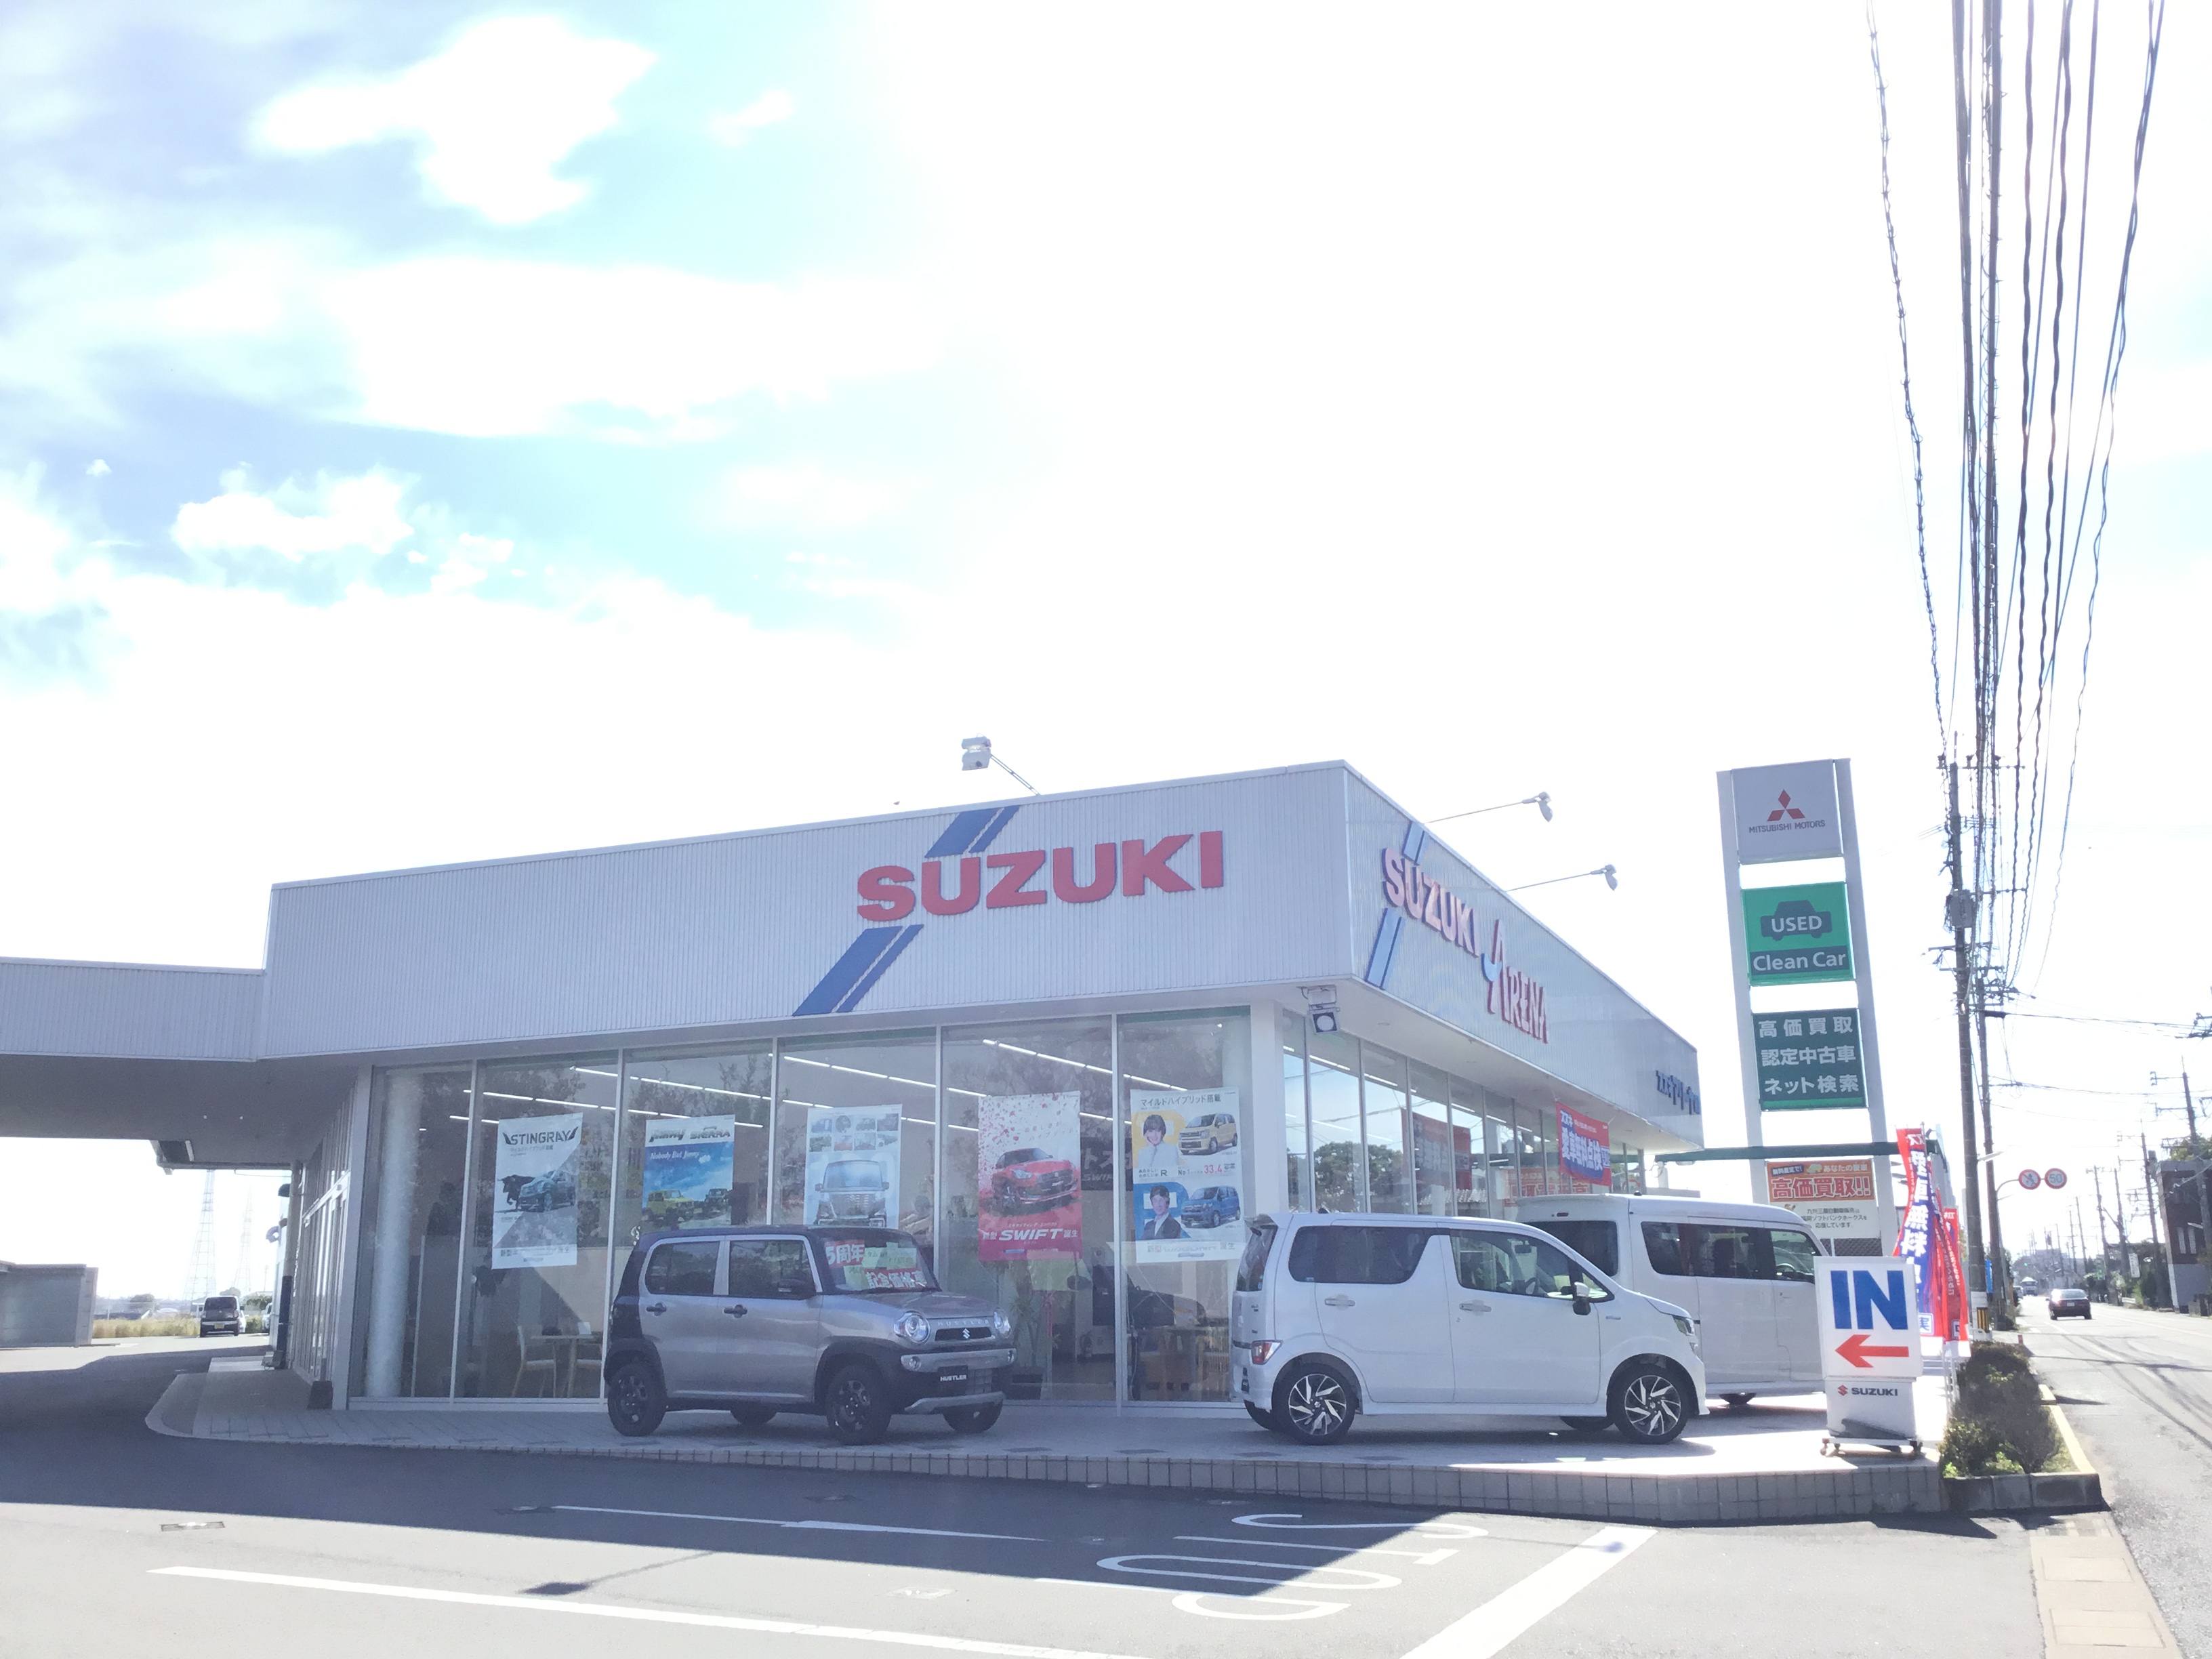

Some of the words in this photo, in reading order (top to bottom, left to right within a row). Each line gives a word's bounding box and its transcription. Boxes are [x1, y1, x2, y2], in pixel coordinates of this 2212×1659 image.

[1748, 823, 1793, 834] MITSUBISHI
[1795, 819, 1826, 830] MOTORS
[857, 830, 1223, 922] SUZUKI
[1771, 915, 1822, 933] USED
[1381, 847, 1480, 958] SUZUKI
[1481, 919, 1549, 1044] ARENA
[1753, 955, 1809, 971] Clean
[1812, 951, 1846, 967] Car
[1758, 1016, 1853, 1038] 高価買取
[1761, 1045, 1856, 1067] 認定中古車
[1764, 1074, 1859, 1095] ネット検索
[1141, 1093, 1222, 1107] マイルドハイブリッド搭載
[510, 1130, 571, 1145] STINGRAY
[2049, 1173, 2063, 1184] 50
[999, 1227, 1063, 1241] SWIFT
[825, 1244, 865, 1265] 5周年
[1830, 1270, 1909, 1330] IN
[1851, 1387, 1899, 1397] SUZUKI
[1034, 1513, 1488, 1620] STOP
